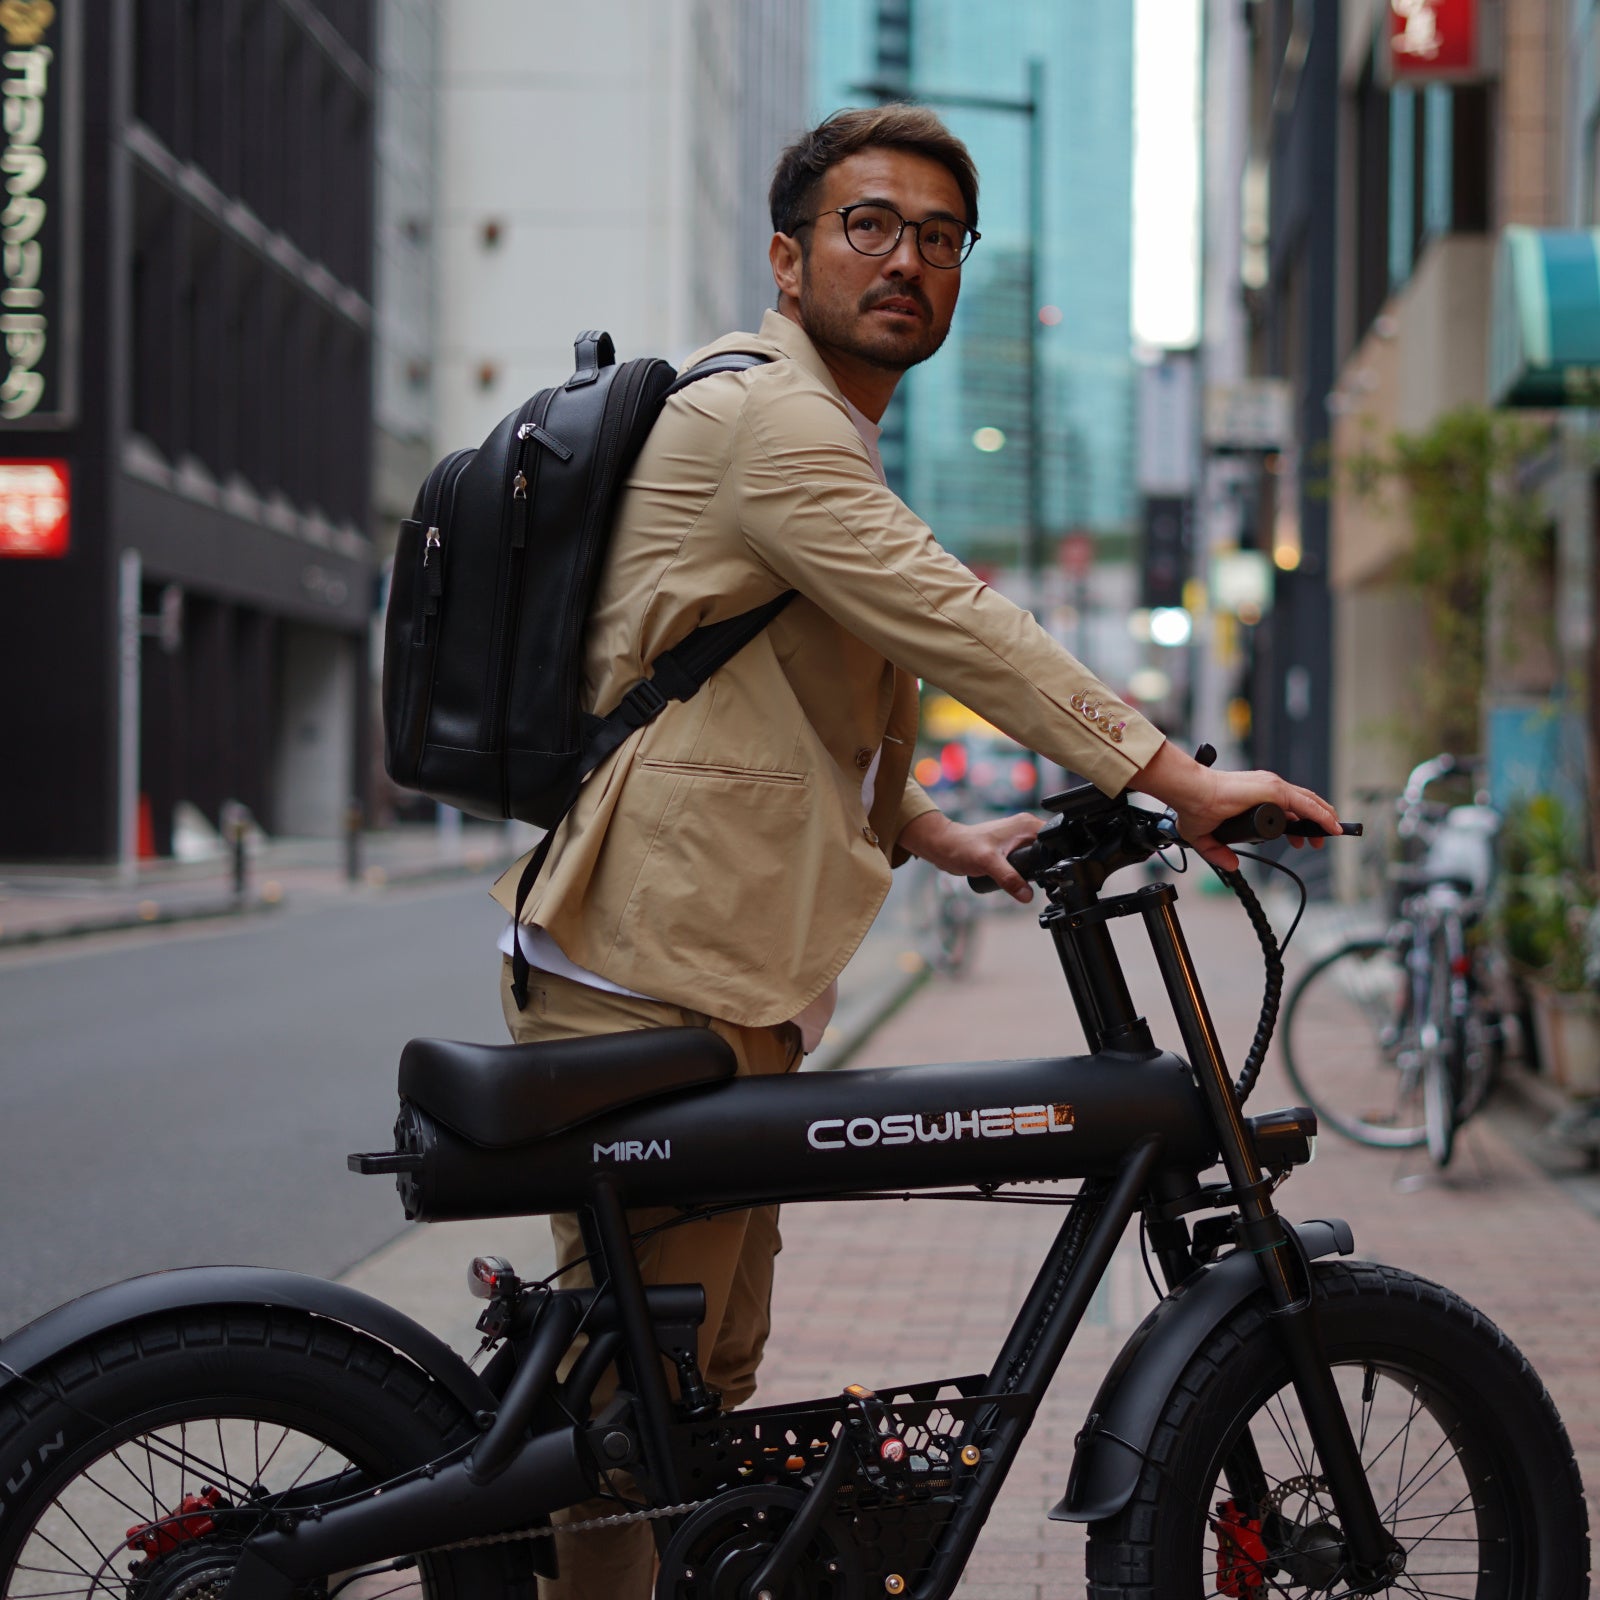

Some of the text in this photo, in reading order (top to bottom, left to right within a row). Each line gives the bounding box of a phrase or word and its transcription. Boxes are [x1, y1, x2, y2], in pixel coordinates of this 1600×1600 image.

[0, 45, 53, 420] ゴリラクリニック
[593, 1139, 671, 1163] MIRAI
[807, 1104, 1074, 1150] COSWHEEL
[0, 1429, 64, 1518] UN
